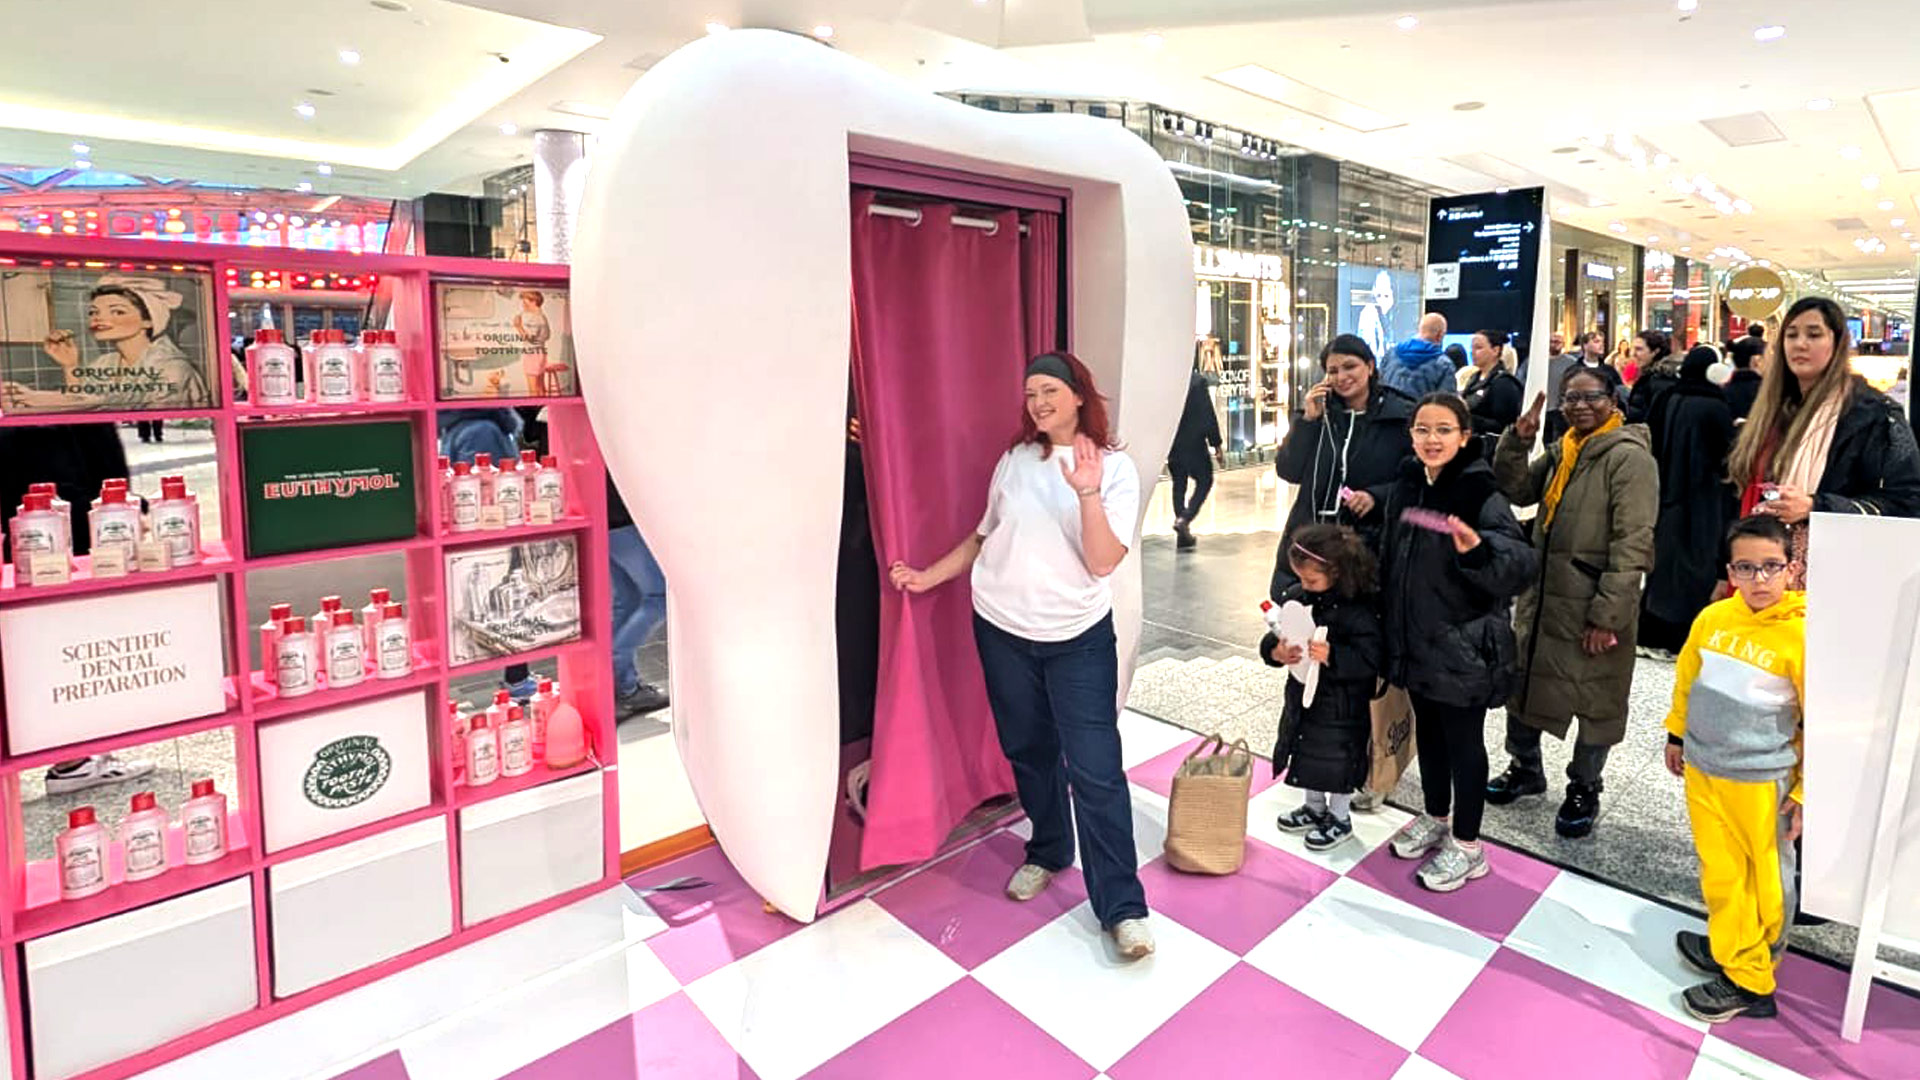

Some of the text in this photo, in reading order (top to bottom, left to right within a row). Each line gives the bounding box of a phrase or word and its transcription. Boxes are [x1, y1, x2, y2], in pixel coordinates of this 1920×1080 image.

[1193, 245, 1283, 281] LLSAINTS
[475, 346, 548, 355] TOOTHPASTE
[483, 333, 540, 345] ORIGINAL
[72, 367, 163, 383] ORIGINAL
[60, 382, 178, 395] TOOTHPASTE
[264, 473, 399, 499] EUTHYMOL
[62, 630, 171, 663] SCIENTIFIC
[1708, 629, 1777, 668] KING
[81, 652, 159, 679] DENTAL
[52, 664, 187, 704] PREPARATION
